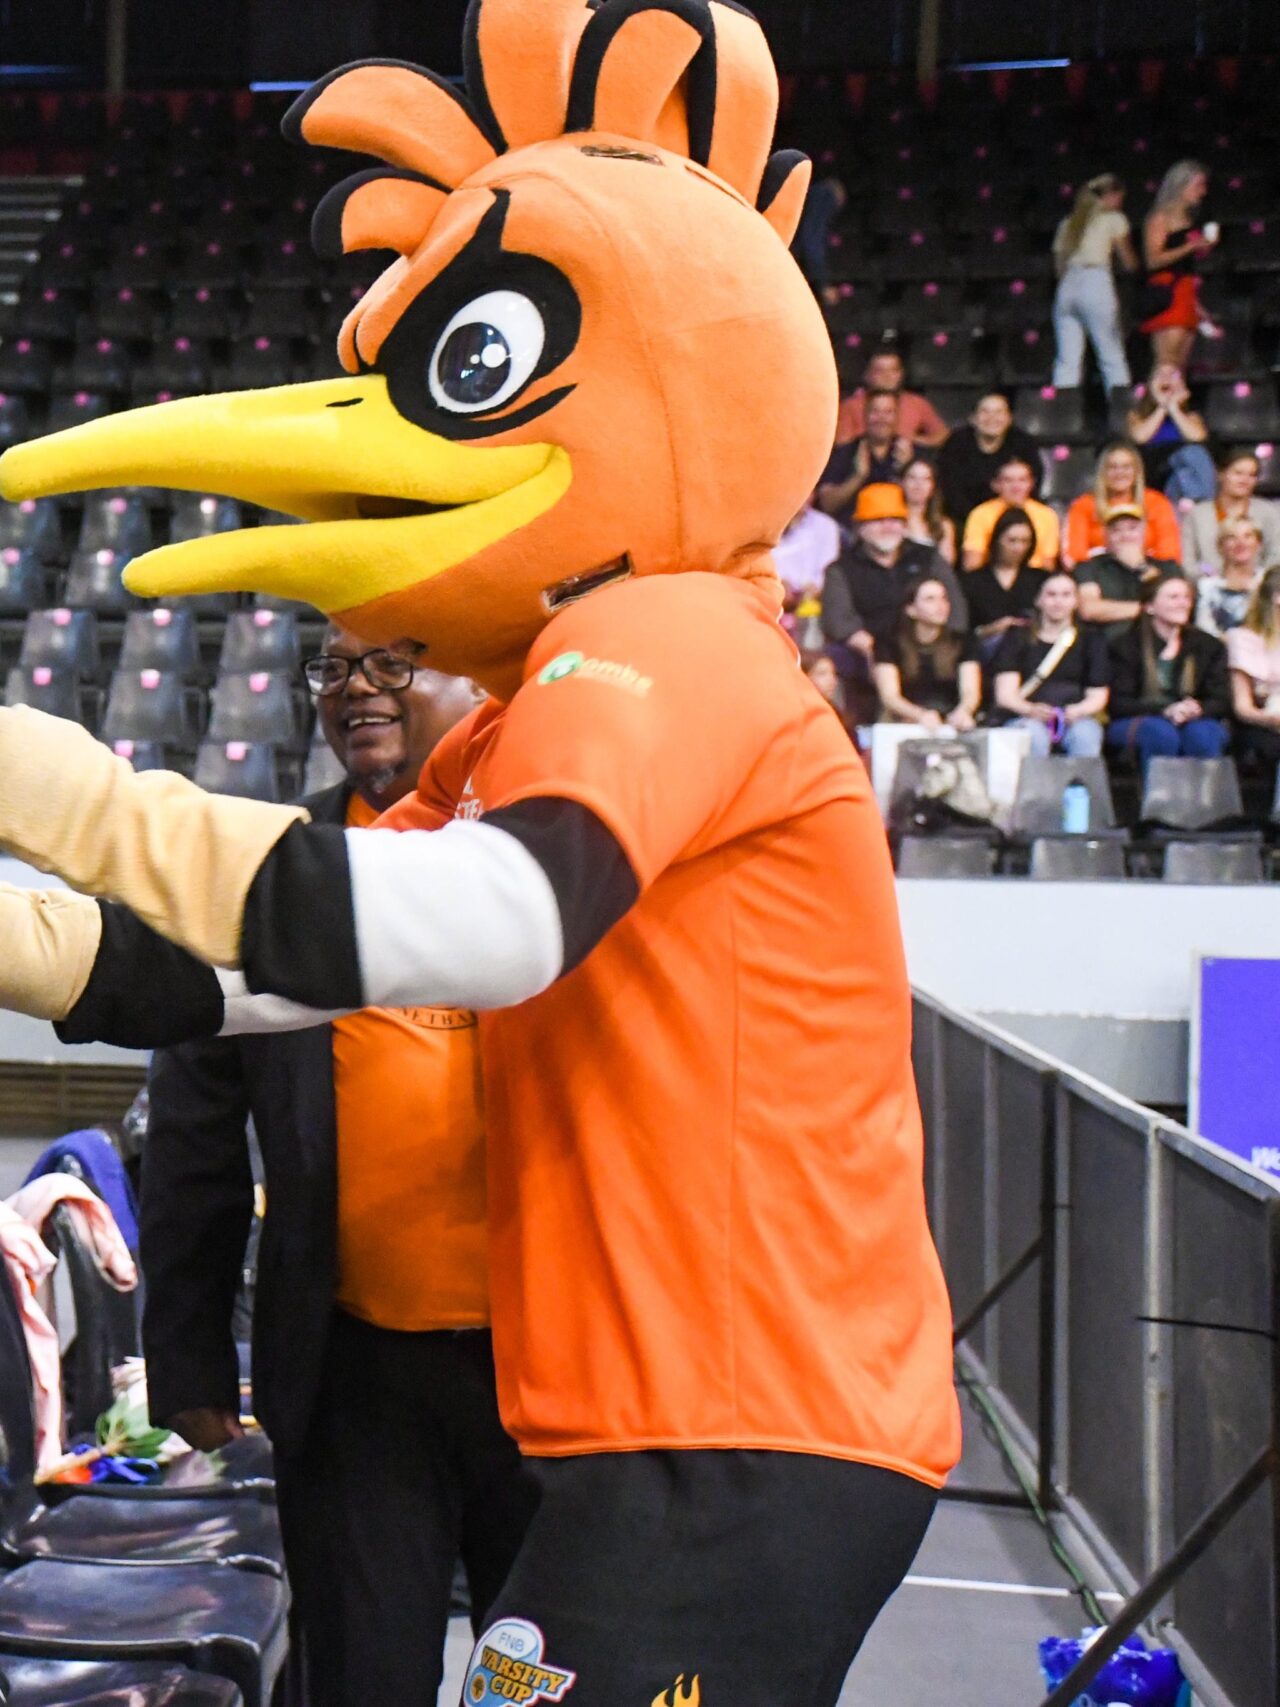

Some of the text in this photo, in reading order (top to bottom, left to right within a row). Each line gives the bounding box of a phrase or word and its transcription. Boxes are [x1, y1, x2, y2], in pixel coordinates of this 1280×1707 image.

[498, 1631, 525, 1653] FNB
[481, 1647, 567, 1693] VARSITY
[490, 1674, 534, 1704] CUP
